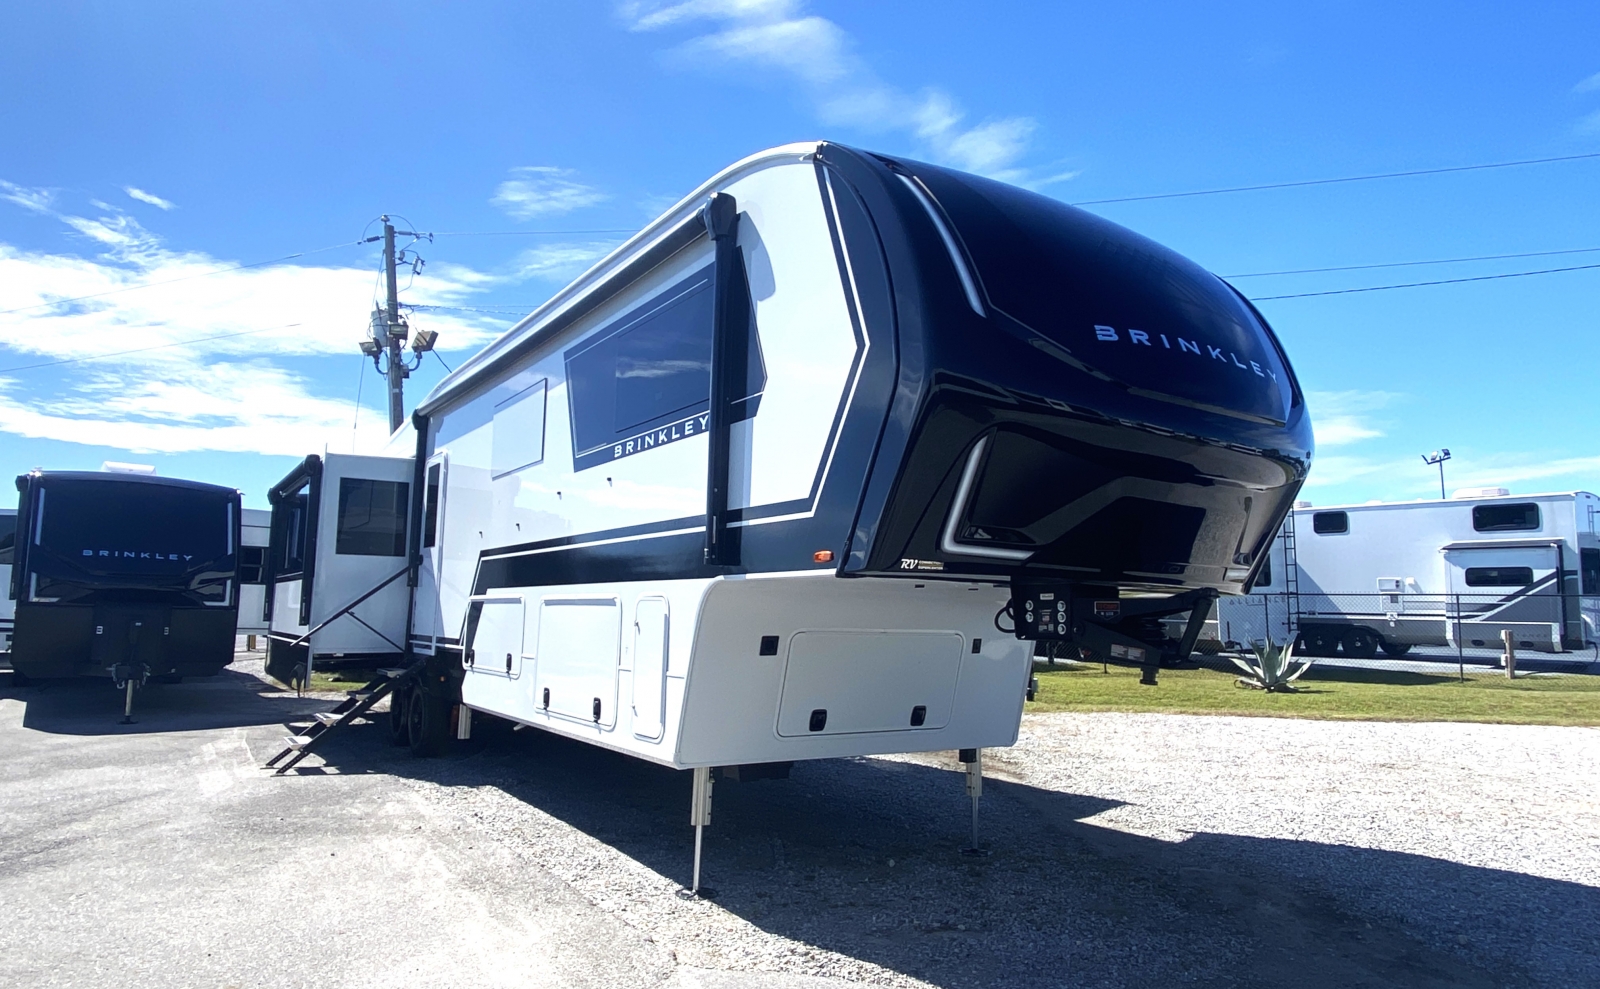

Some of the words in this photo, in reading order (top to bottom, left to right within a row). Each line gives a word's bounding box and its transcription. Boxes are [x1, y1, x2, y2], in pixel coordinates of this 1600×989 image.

[1094, 325, 1277, 384] BRINKLEY
[614, 415, 709, 458] BRINKLEY
[82, 549, 193, 561] BRINKLEY
[900, 558, 918, 569] RV
